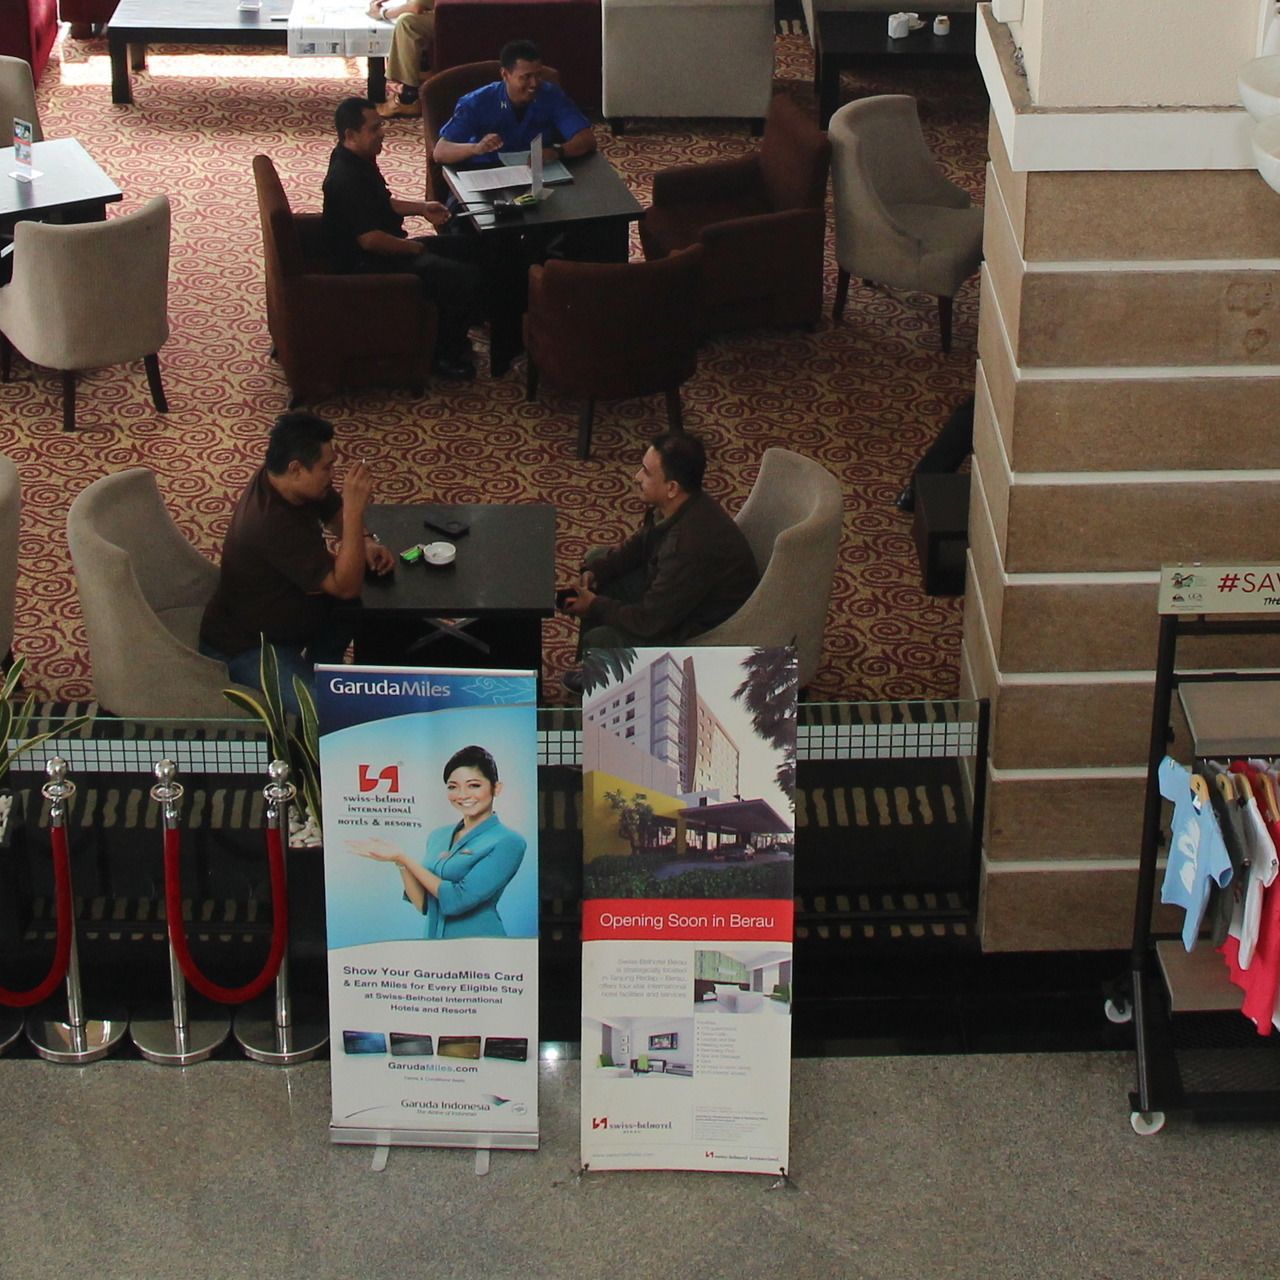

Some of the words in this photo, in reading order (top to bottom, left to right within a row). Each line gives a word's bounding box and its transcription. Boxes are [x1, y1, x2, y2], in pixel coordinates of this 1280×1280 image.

[330, 677, 451, 697] GarudaMiles
[600, 913, 664, 929] Opening
[668, 914, 708, 927] Soon
[713, 914, 725, 927] in
[730, 914, 774, 928] Berau
[343, 966, 377, 975] Show
[381, 967, 409, 977] Your
[414, 969, 490, 980] GarudaMiles
[494, 971, 523, 982] Card
[354, 980, 378, 988] Earn
[381, 981, 407, 989] Miles
[411, 982, 424, 990] for
[428, 983, 456, 993] Every
[460, 984, 498, 994] Eligible
[501, 986, 524, 995] Stay
[376, 993, 443, 1003] Swiss-Belhotel
[391, 1004, 420, 1012] Hotels
[422, 1006, 439, 1014] and
[388, 1062, 478, 1073] GarudaMiles.com
[401, 1099, 438, 1109] Garuda
[441, 1100, 491, 1111] Indonesia
